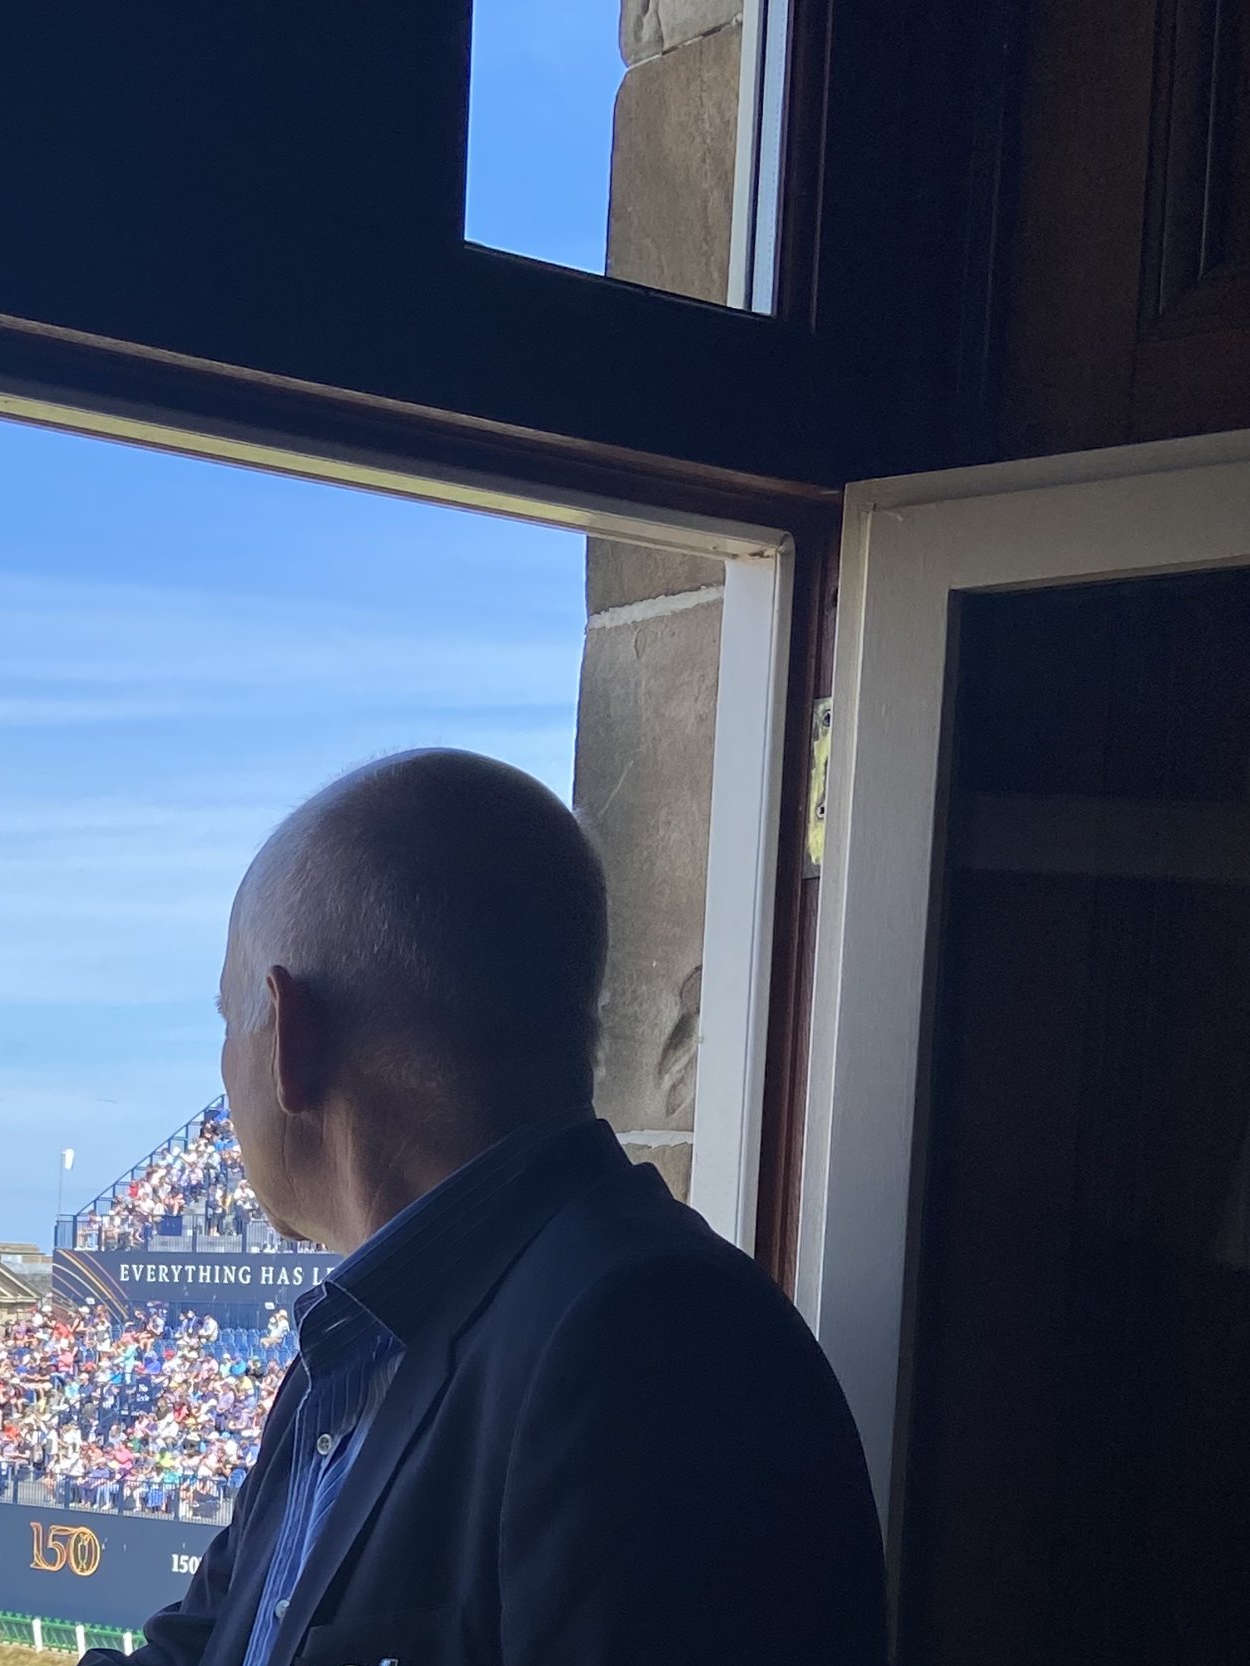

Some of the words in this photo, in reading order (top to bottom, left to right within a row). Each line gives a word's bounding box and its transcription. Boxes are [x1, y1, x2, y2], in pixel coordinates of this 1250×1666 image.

[119, 1263, 251, 1284] EVERYTHING
[260, 1266, 303, 1286] HAS
[29, 1521, 101, 1576] 150
